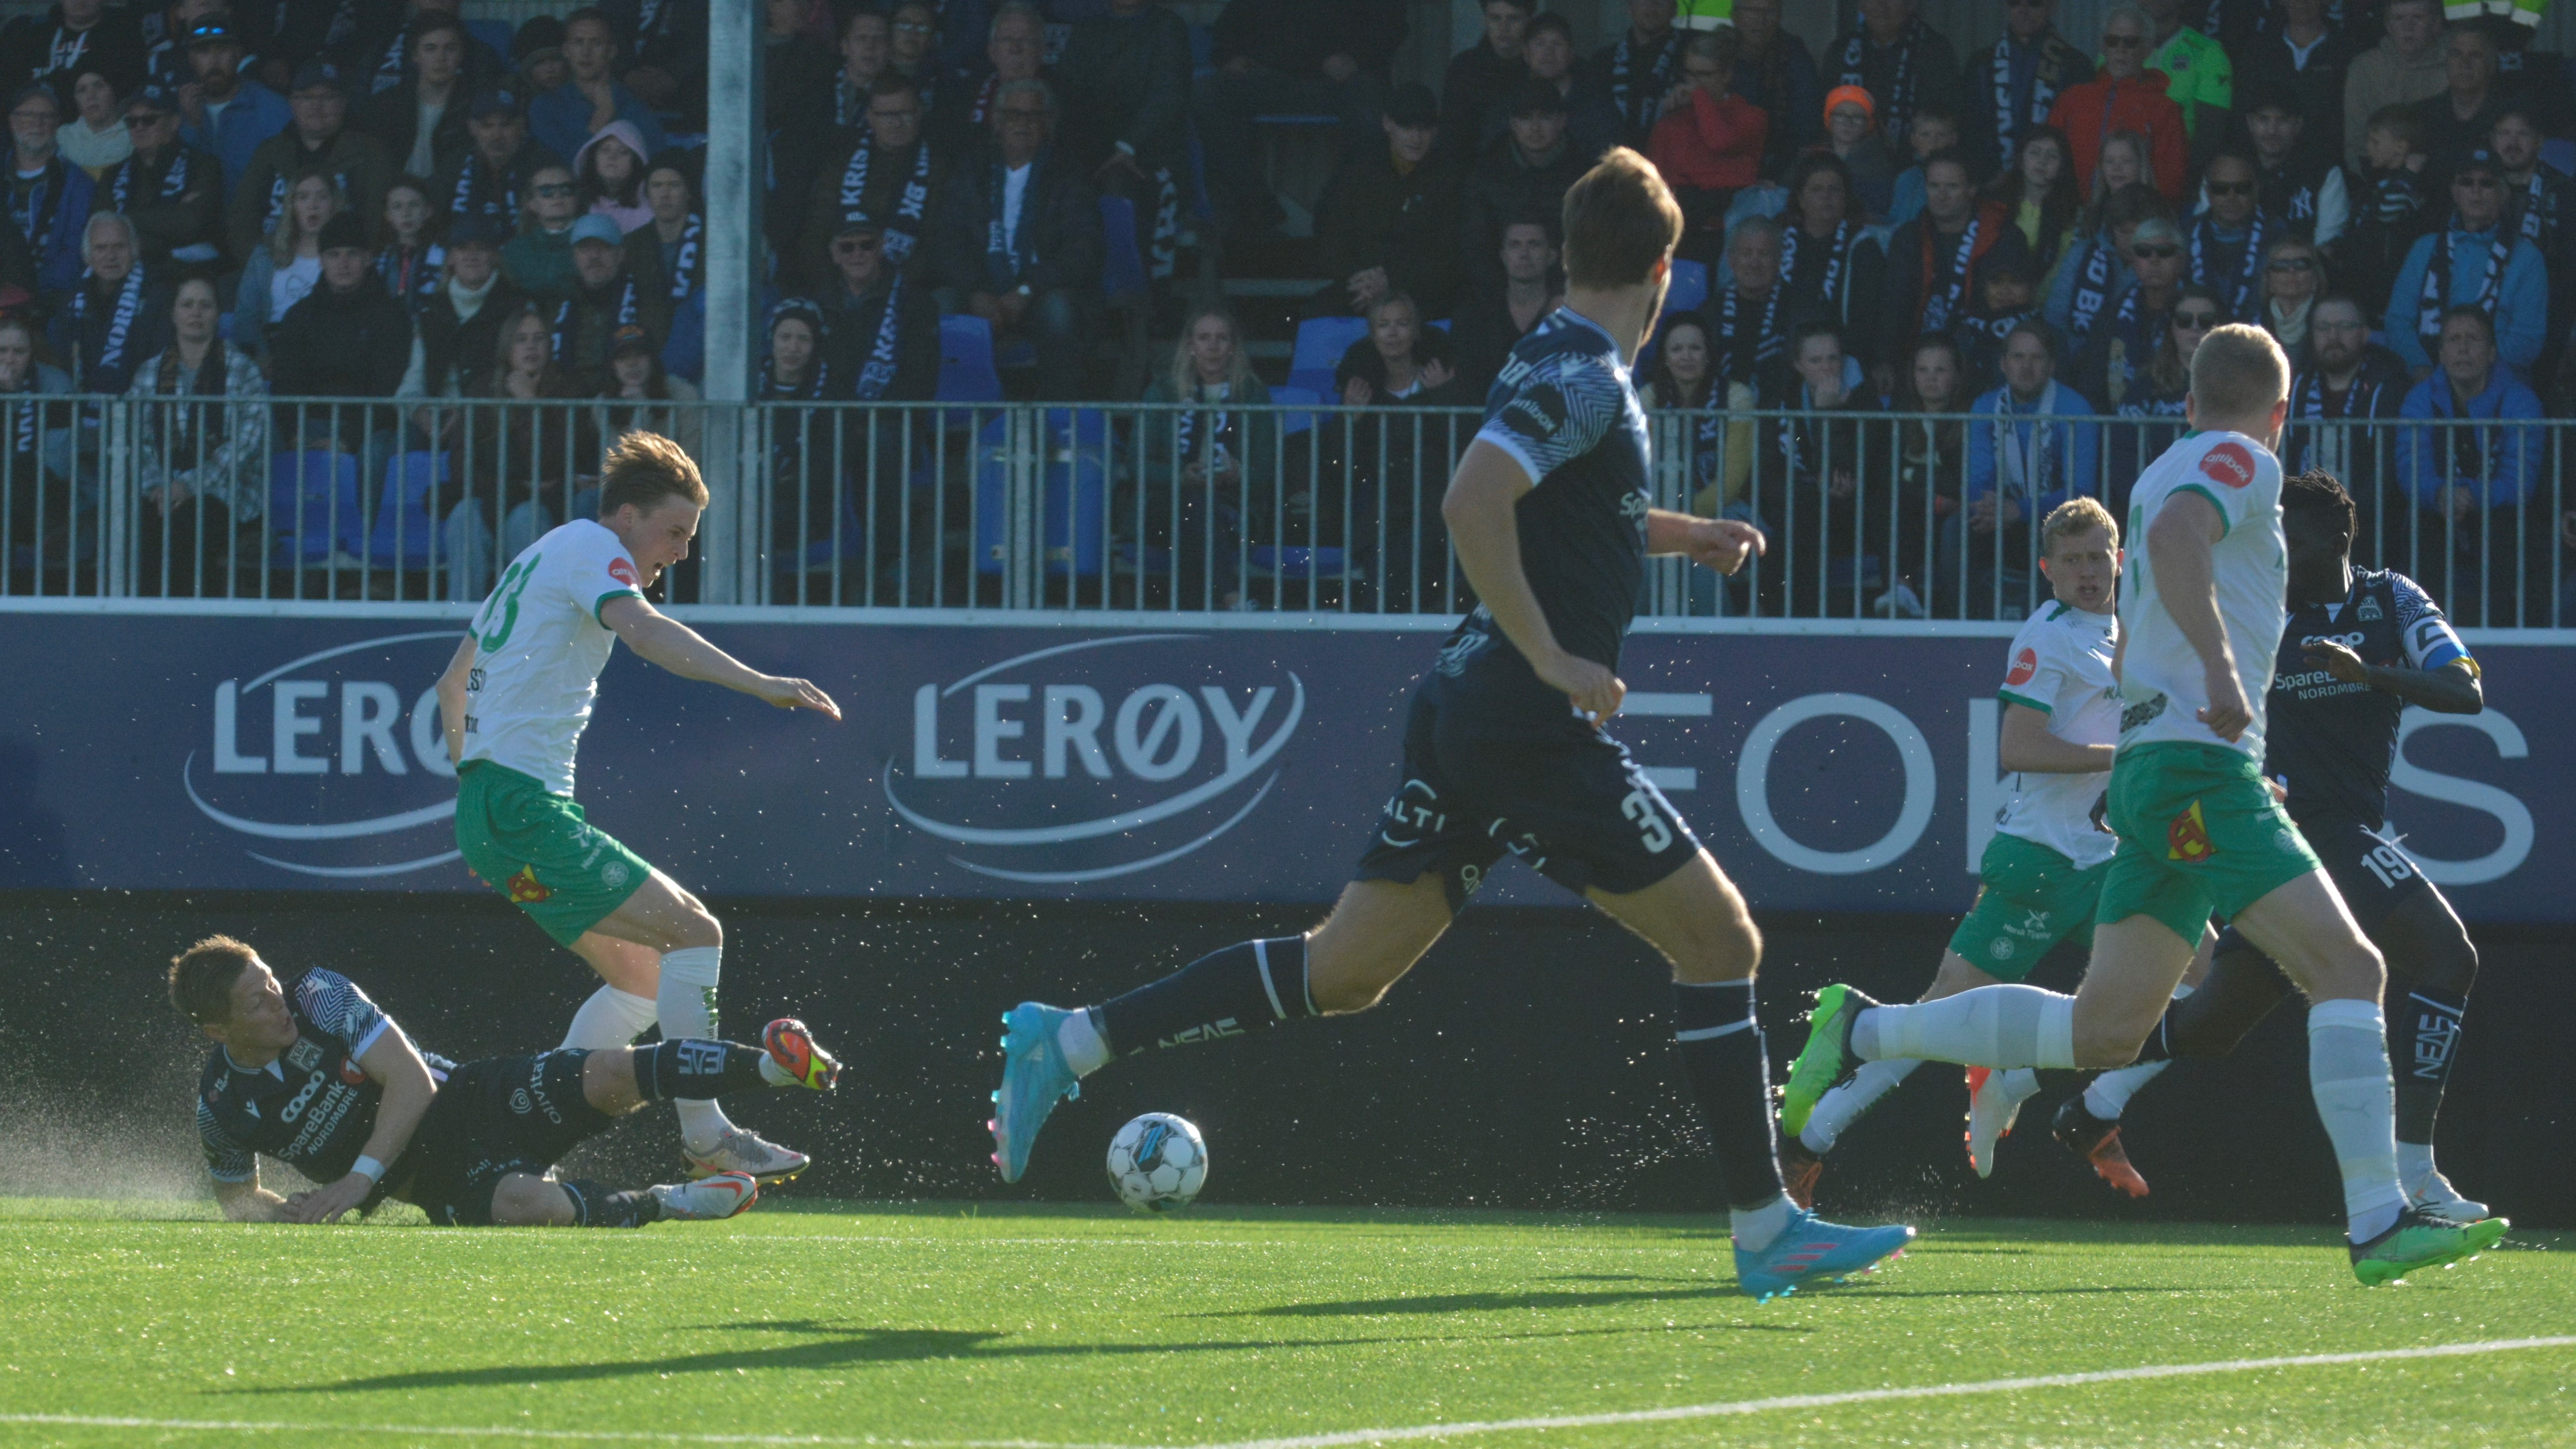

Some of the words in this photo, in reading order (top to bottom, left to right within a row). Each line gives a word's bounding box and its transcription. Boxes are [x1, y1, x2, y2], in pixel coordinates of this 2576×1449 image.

[2205, 453, 2250, 477] altibox
[2275, 671, 2337, 692] Spare
[214, 679, 460, 777] LERØ
[914, 683, 1278, 781] LERØY
[1384, 796, 1446, 833] ALTI
[1621, 792, 1673, 855] 3
[2360, 846, 2412, 890] 19
[2002, 923, 2025, 937] Norsk
[2413, 1013, 2460, 1079] NEAS
[277, 1080, 346, 1160] SpareBank
[307, 1087, 358, 1155] NORDMØRE
